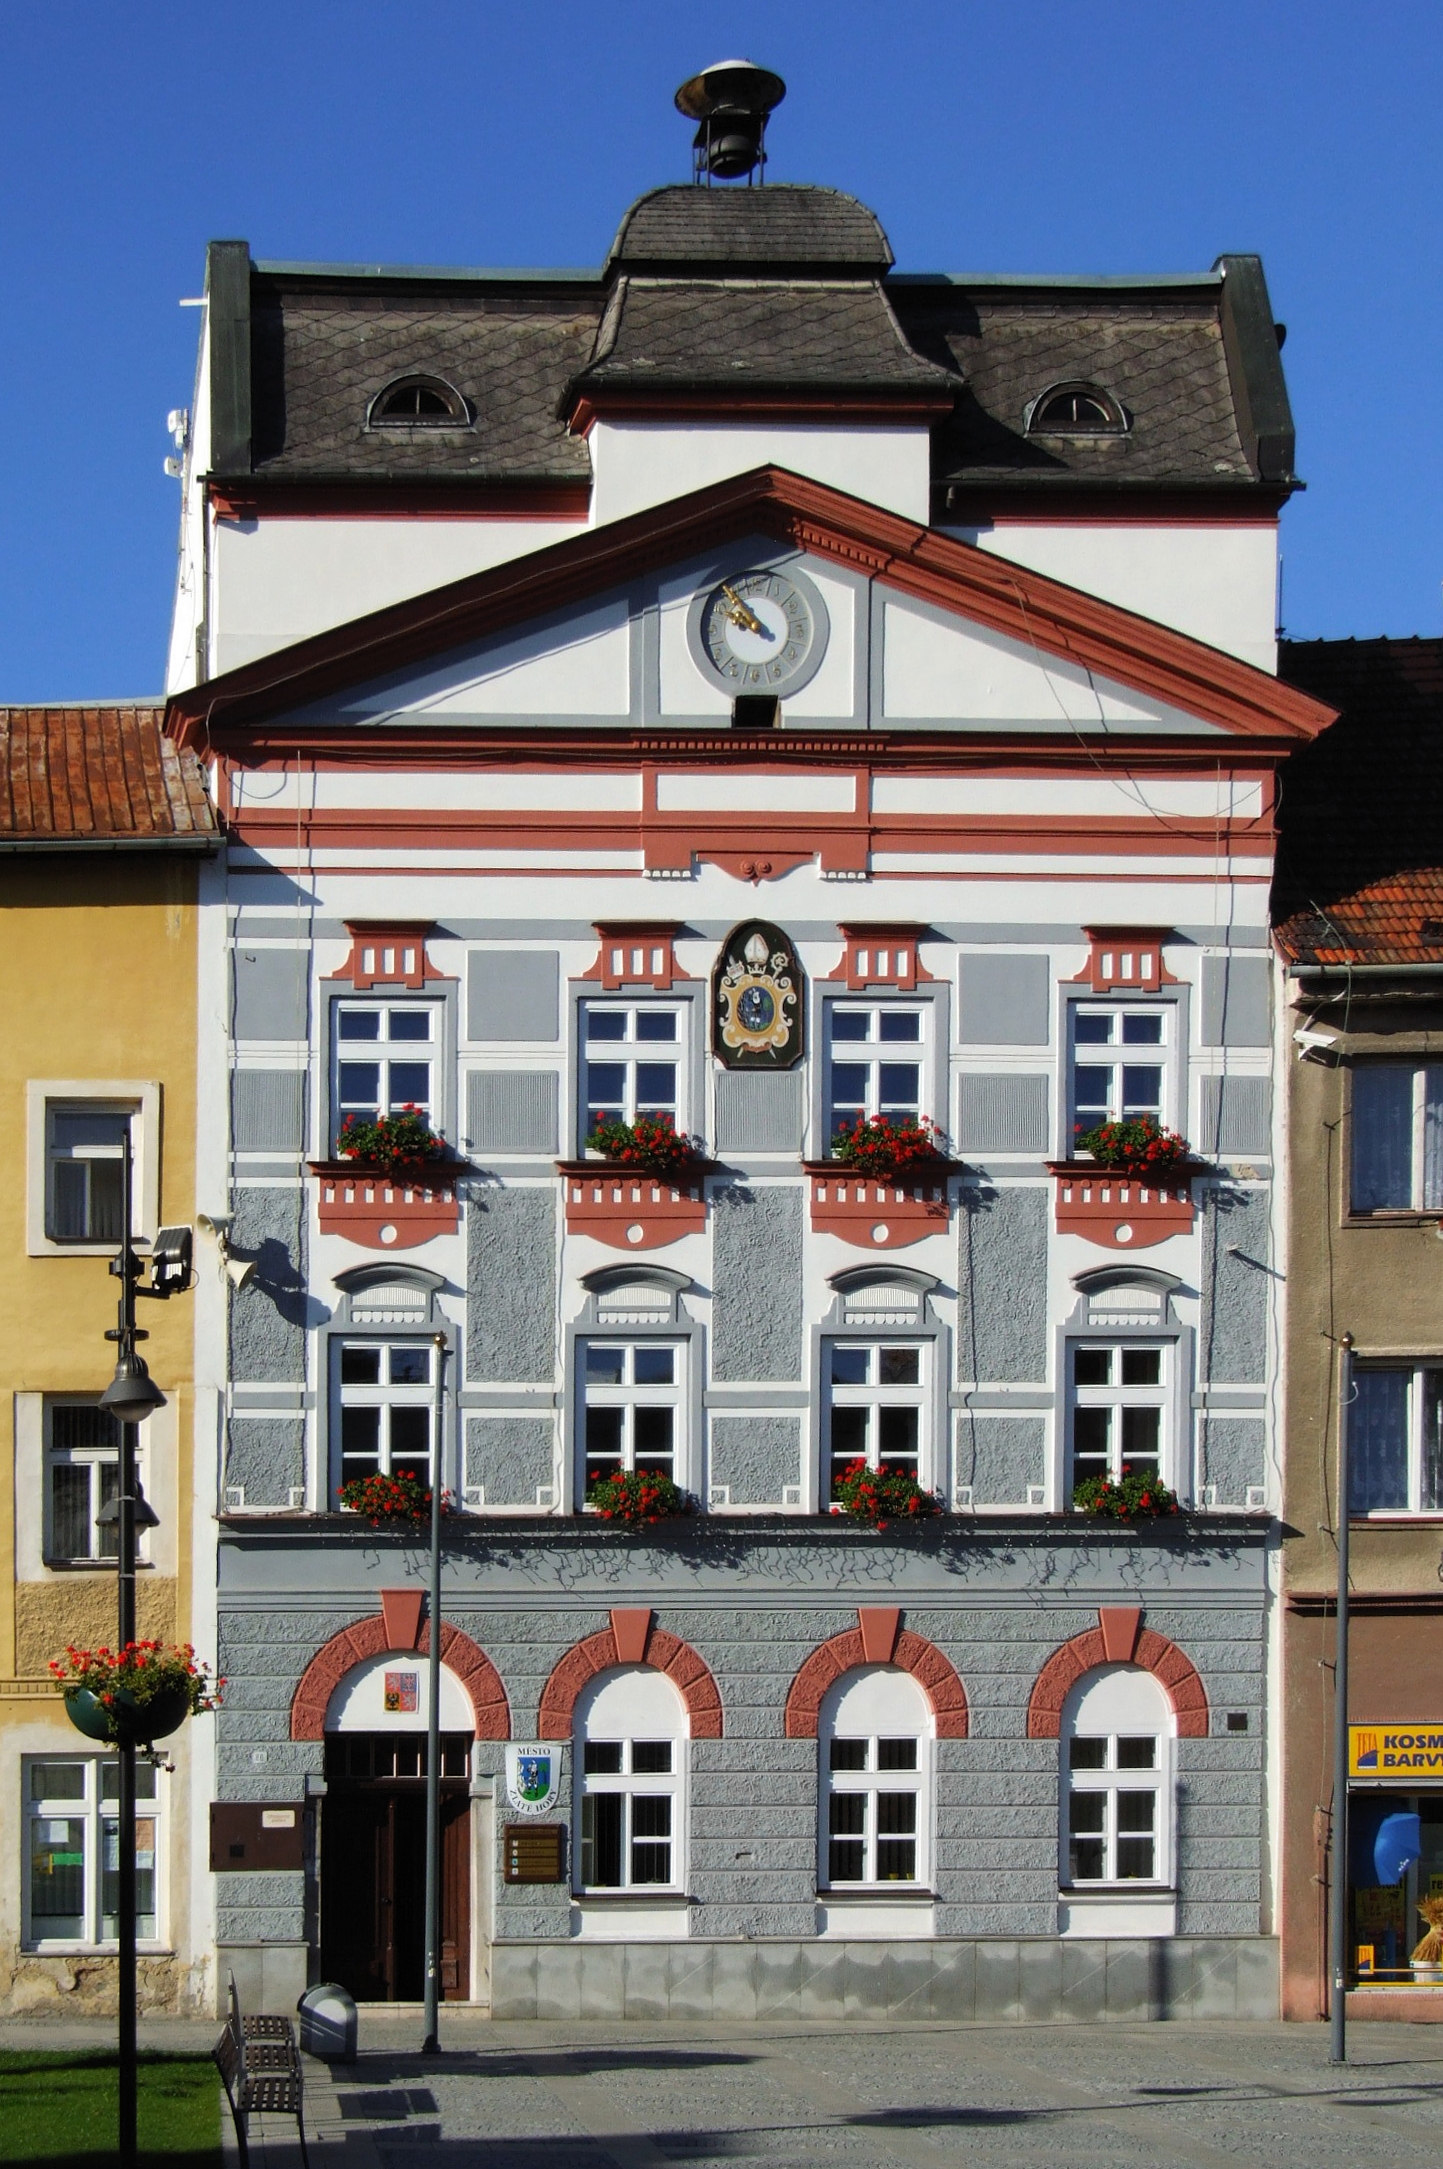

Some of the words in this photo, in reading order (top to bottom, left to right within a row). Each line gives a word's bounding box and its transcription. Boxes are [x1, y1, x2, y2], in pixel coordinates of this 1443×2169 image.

[750, 668, 760, 683] 6
[773, 664, 782, 678] 5
[1384, 1734, 1443, 1749] KOSM
[518, 1746, 551, 1755] MĚSTO
[509, 1789, 532, 1812] ZLATÉ
[536, 1788, 557, 1812] HORY
